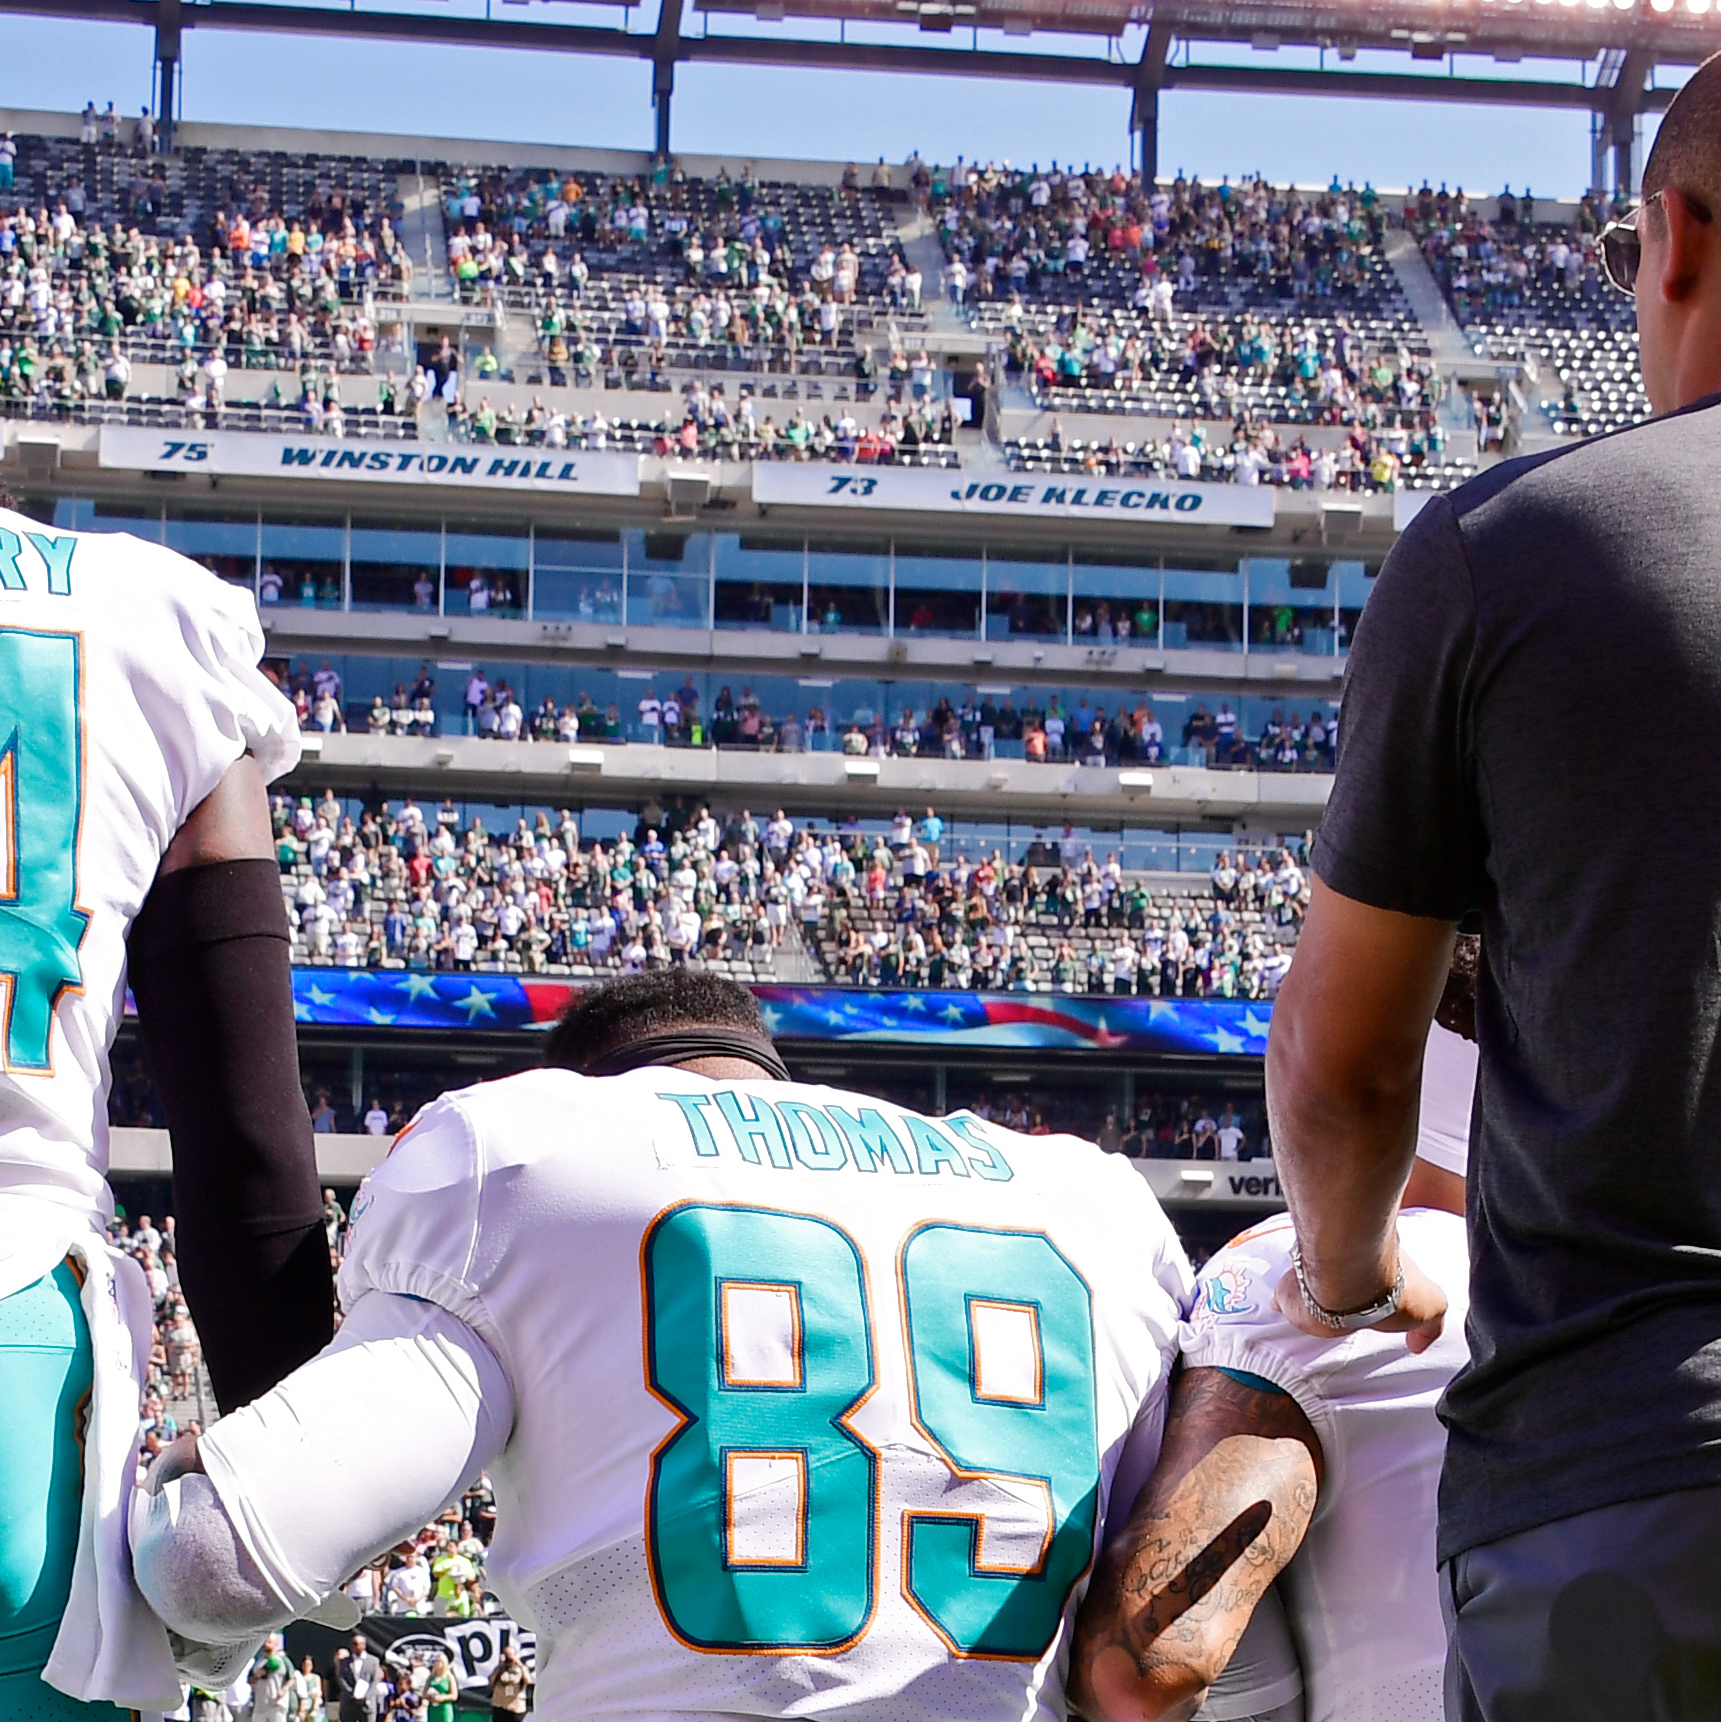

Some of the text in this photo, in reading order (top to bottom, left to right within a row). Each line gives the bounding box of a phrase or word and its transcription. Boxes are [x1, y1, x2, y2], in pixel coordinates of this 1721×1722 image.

[158, 441, 579, 481] 75 WINSTON HILL
[826, 475, 1203, 512] 73 JOE KLECKO
[657, 1090, 1015, 1183] THOMAS
[1228, 1174, 1282, 1196] veri
[639, 1197, 1101, 1663] 89
